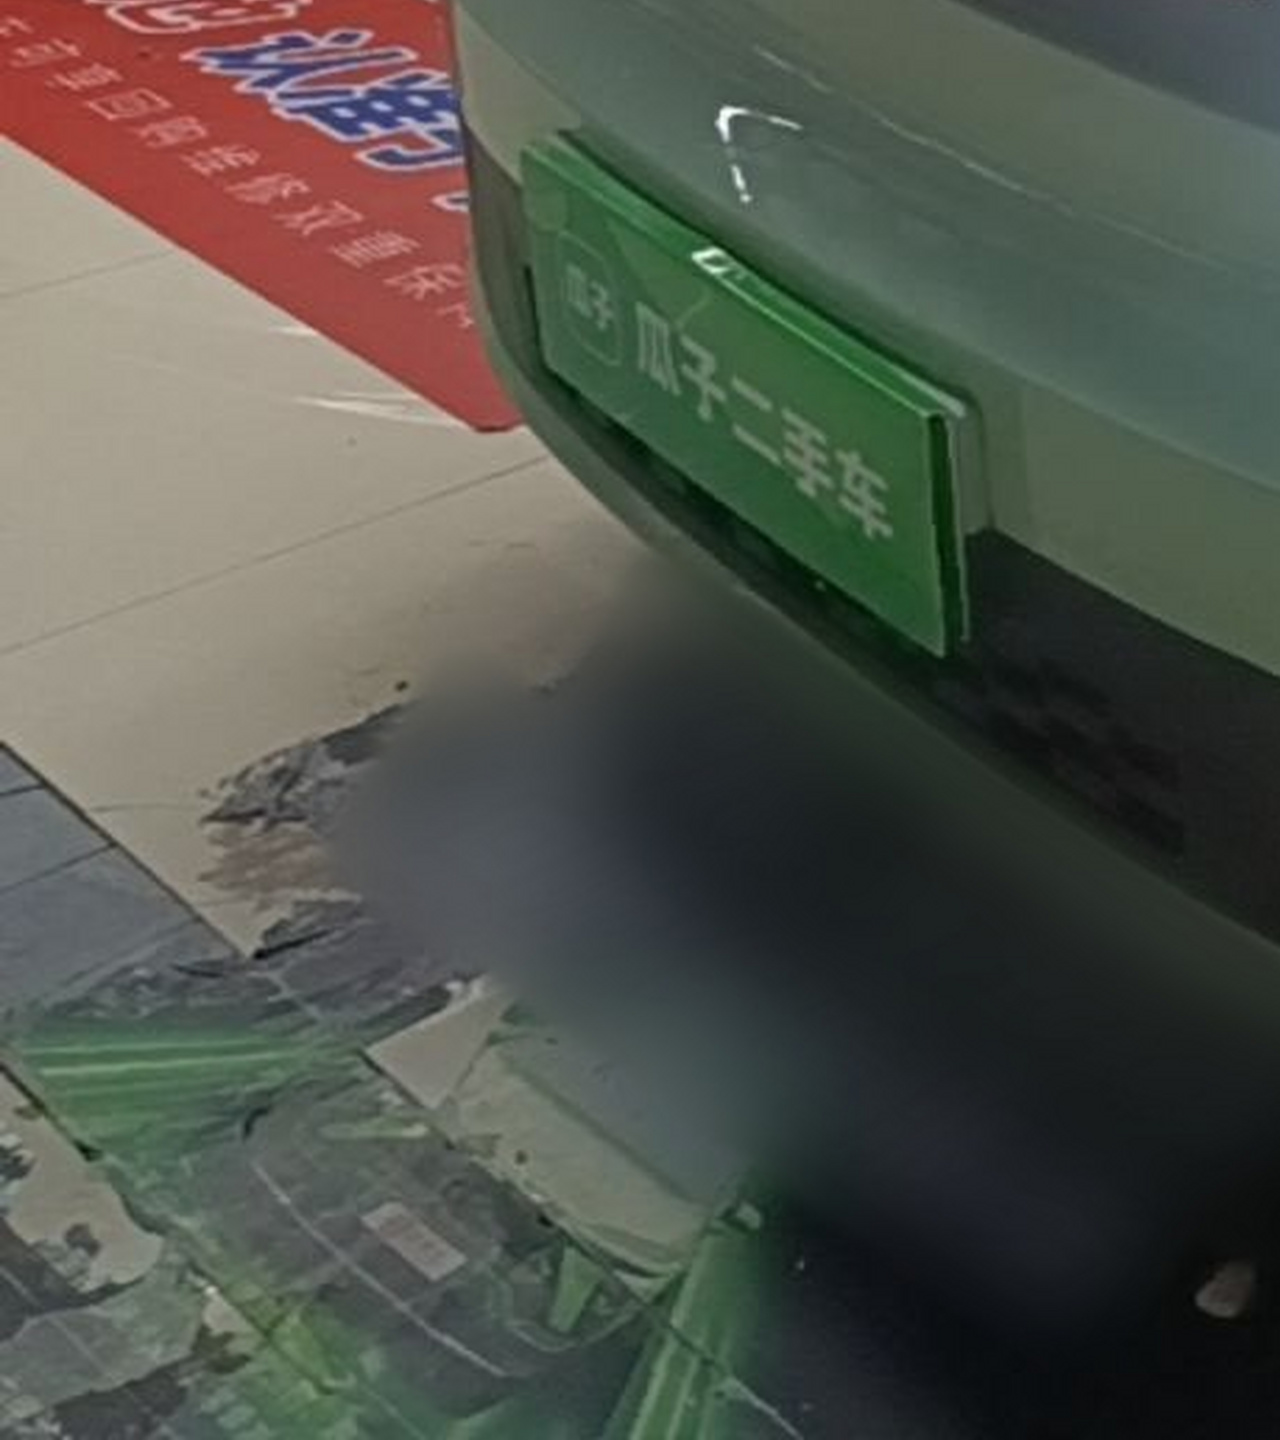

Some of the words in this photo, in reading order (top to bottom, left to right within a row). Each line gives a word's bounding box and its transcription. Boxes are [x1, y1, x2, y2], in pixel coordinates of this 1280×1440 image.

[635, 300, 893, 540] 瓜子二手车
